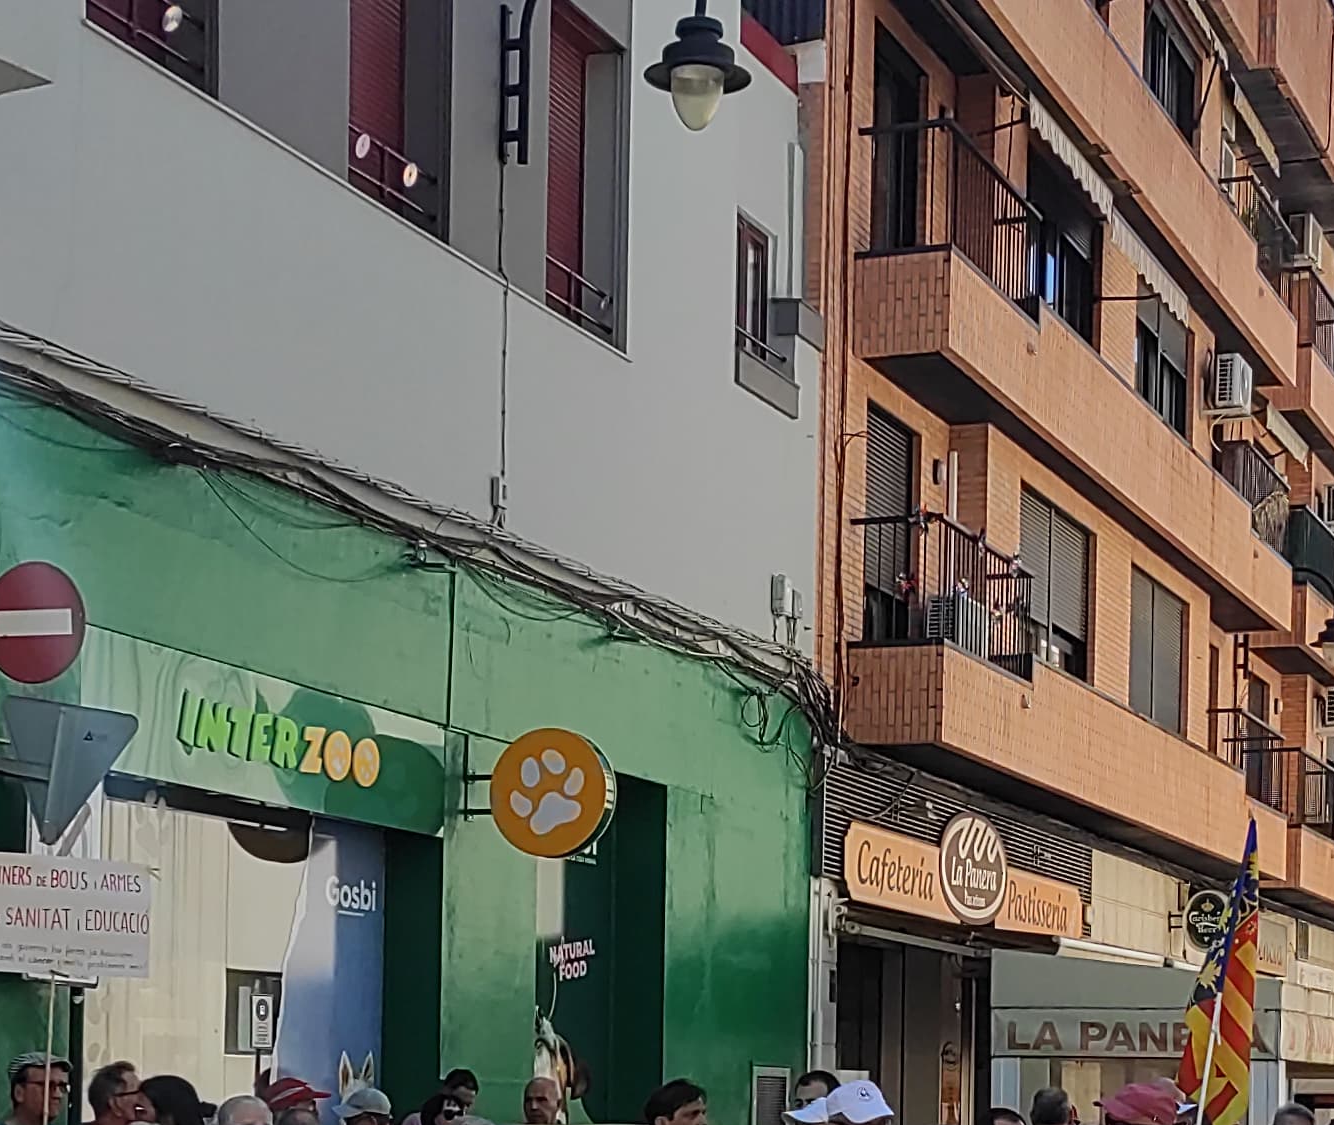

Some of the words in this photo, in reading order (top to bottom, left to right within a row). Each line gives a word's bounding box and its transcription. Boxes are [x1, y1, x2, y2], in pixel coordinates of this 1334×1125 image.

[177, 688, 380, 787] INTERZOO
[36, 877, 47, 887] DE
[50, 868, 88, 890] BOUS
[100, 873, 142, 893] ARMES
[857, 840, 934, 901] Cafeteria
[951, 857, 963, 885] La
[965, 858, 997, 891] Panera
[325, 875, 376, 911] Gosbi
[1007, 880, 1068, 932] Pastisseria
[5, 907, 71, 930] SANITAT
[85, 910, 149, 935] EDUCACIÓ
[1189, 911, 1220, 925] Carlsber
[549, 937, 595, 966] NATURAL
[559, 961, 587, 981] FOOD
[1007, 1021, 1062, 1051] LA
[1079, 1021, 1266, 1052] PANEA
